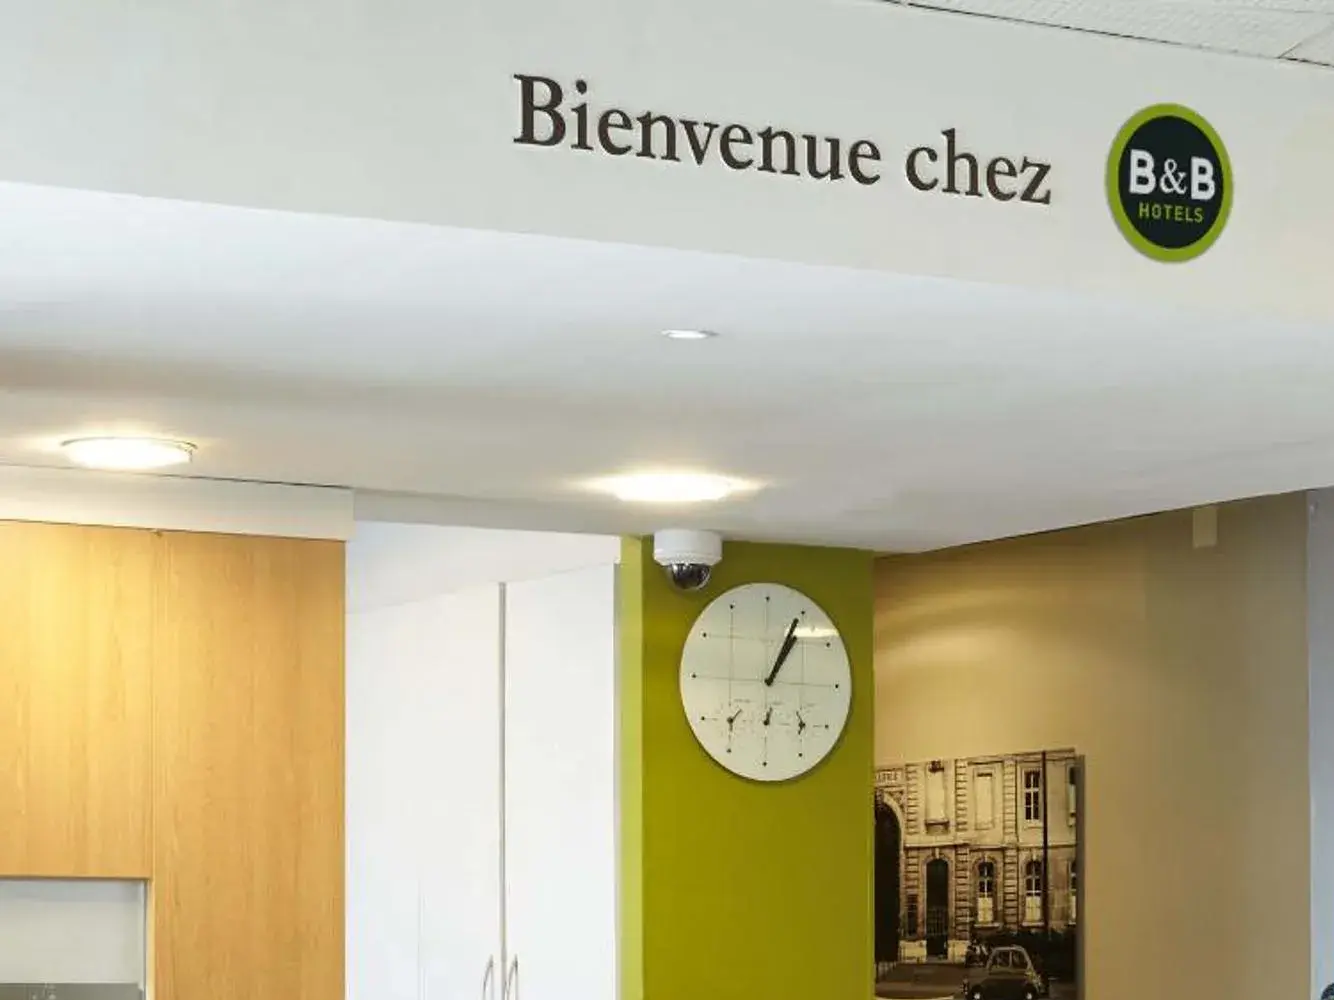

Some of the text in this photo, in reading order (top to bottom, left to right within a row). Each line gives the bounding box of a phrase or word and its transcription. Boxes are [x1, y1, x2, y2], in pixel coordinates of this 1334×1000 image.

[512, 73, 1052, 205] Bienvenue chez
[1128, 148, 1216, 201] B&B
[1138, 201, 1204, 224] HOTELS
